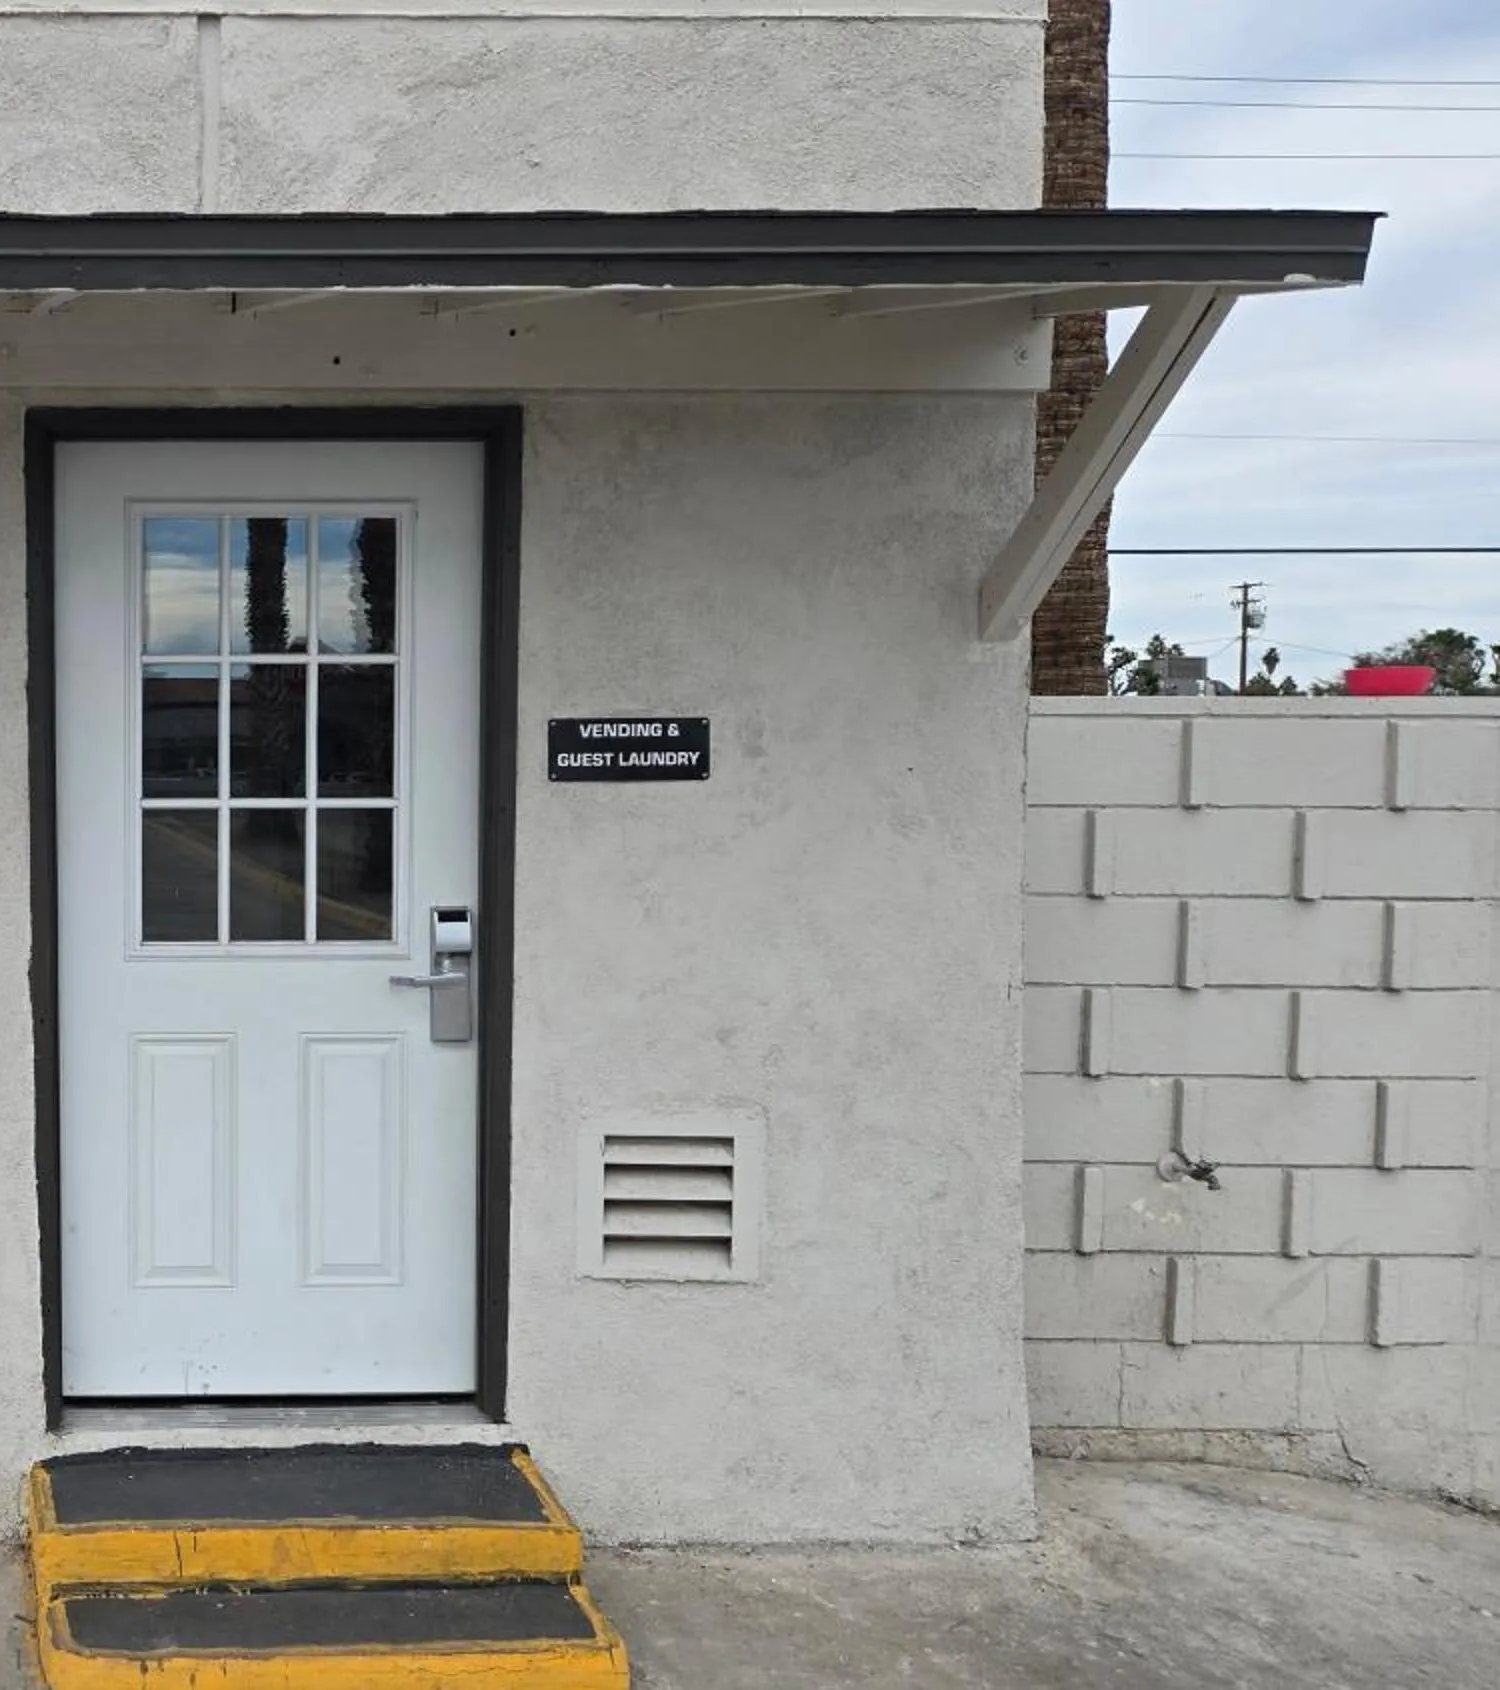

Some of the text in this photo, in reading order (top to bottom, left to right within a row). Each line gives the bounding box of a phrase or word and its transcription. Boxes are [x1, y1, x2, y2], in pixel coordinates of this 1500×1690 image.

[579, 723, 680, 738] VENDING &
[557, 751, 700, 767] GUEST LAUNDRY
